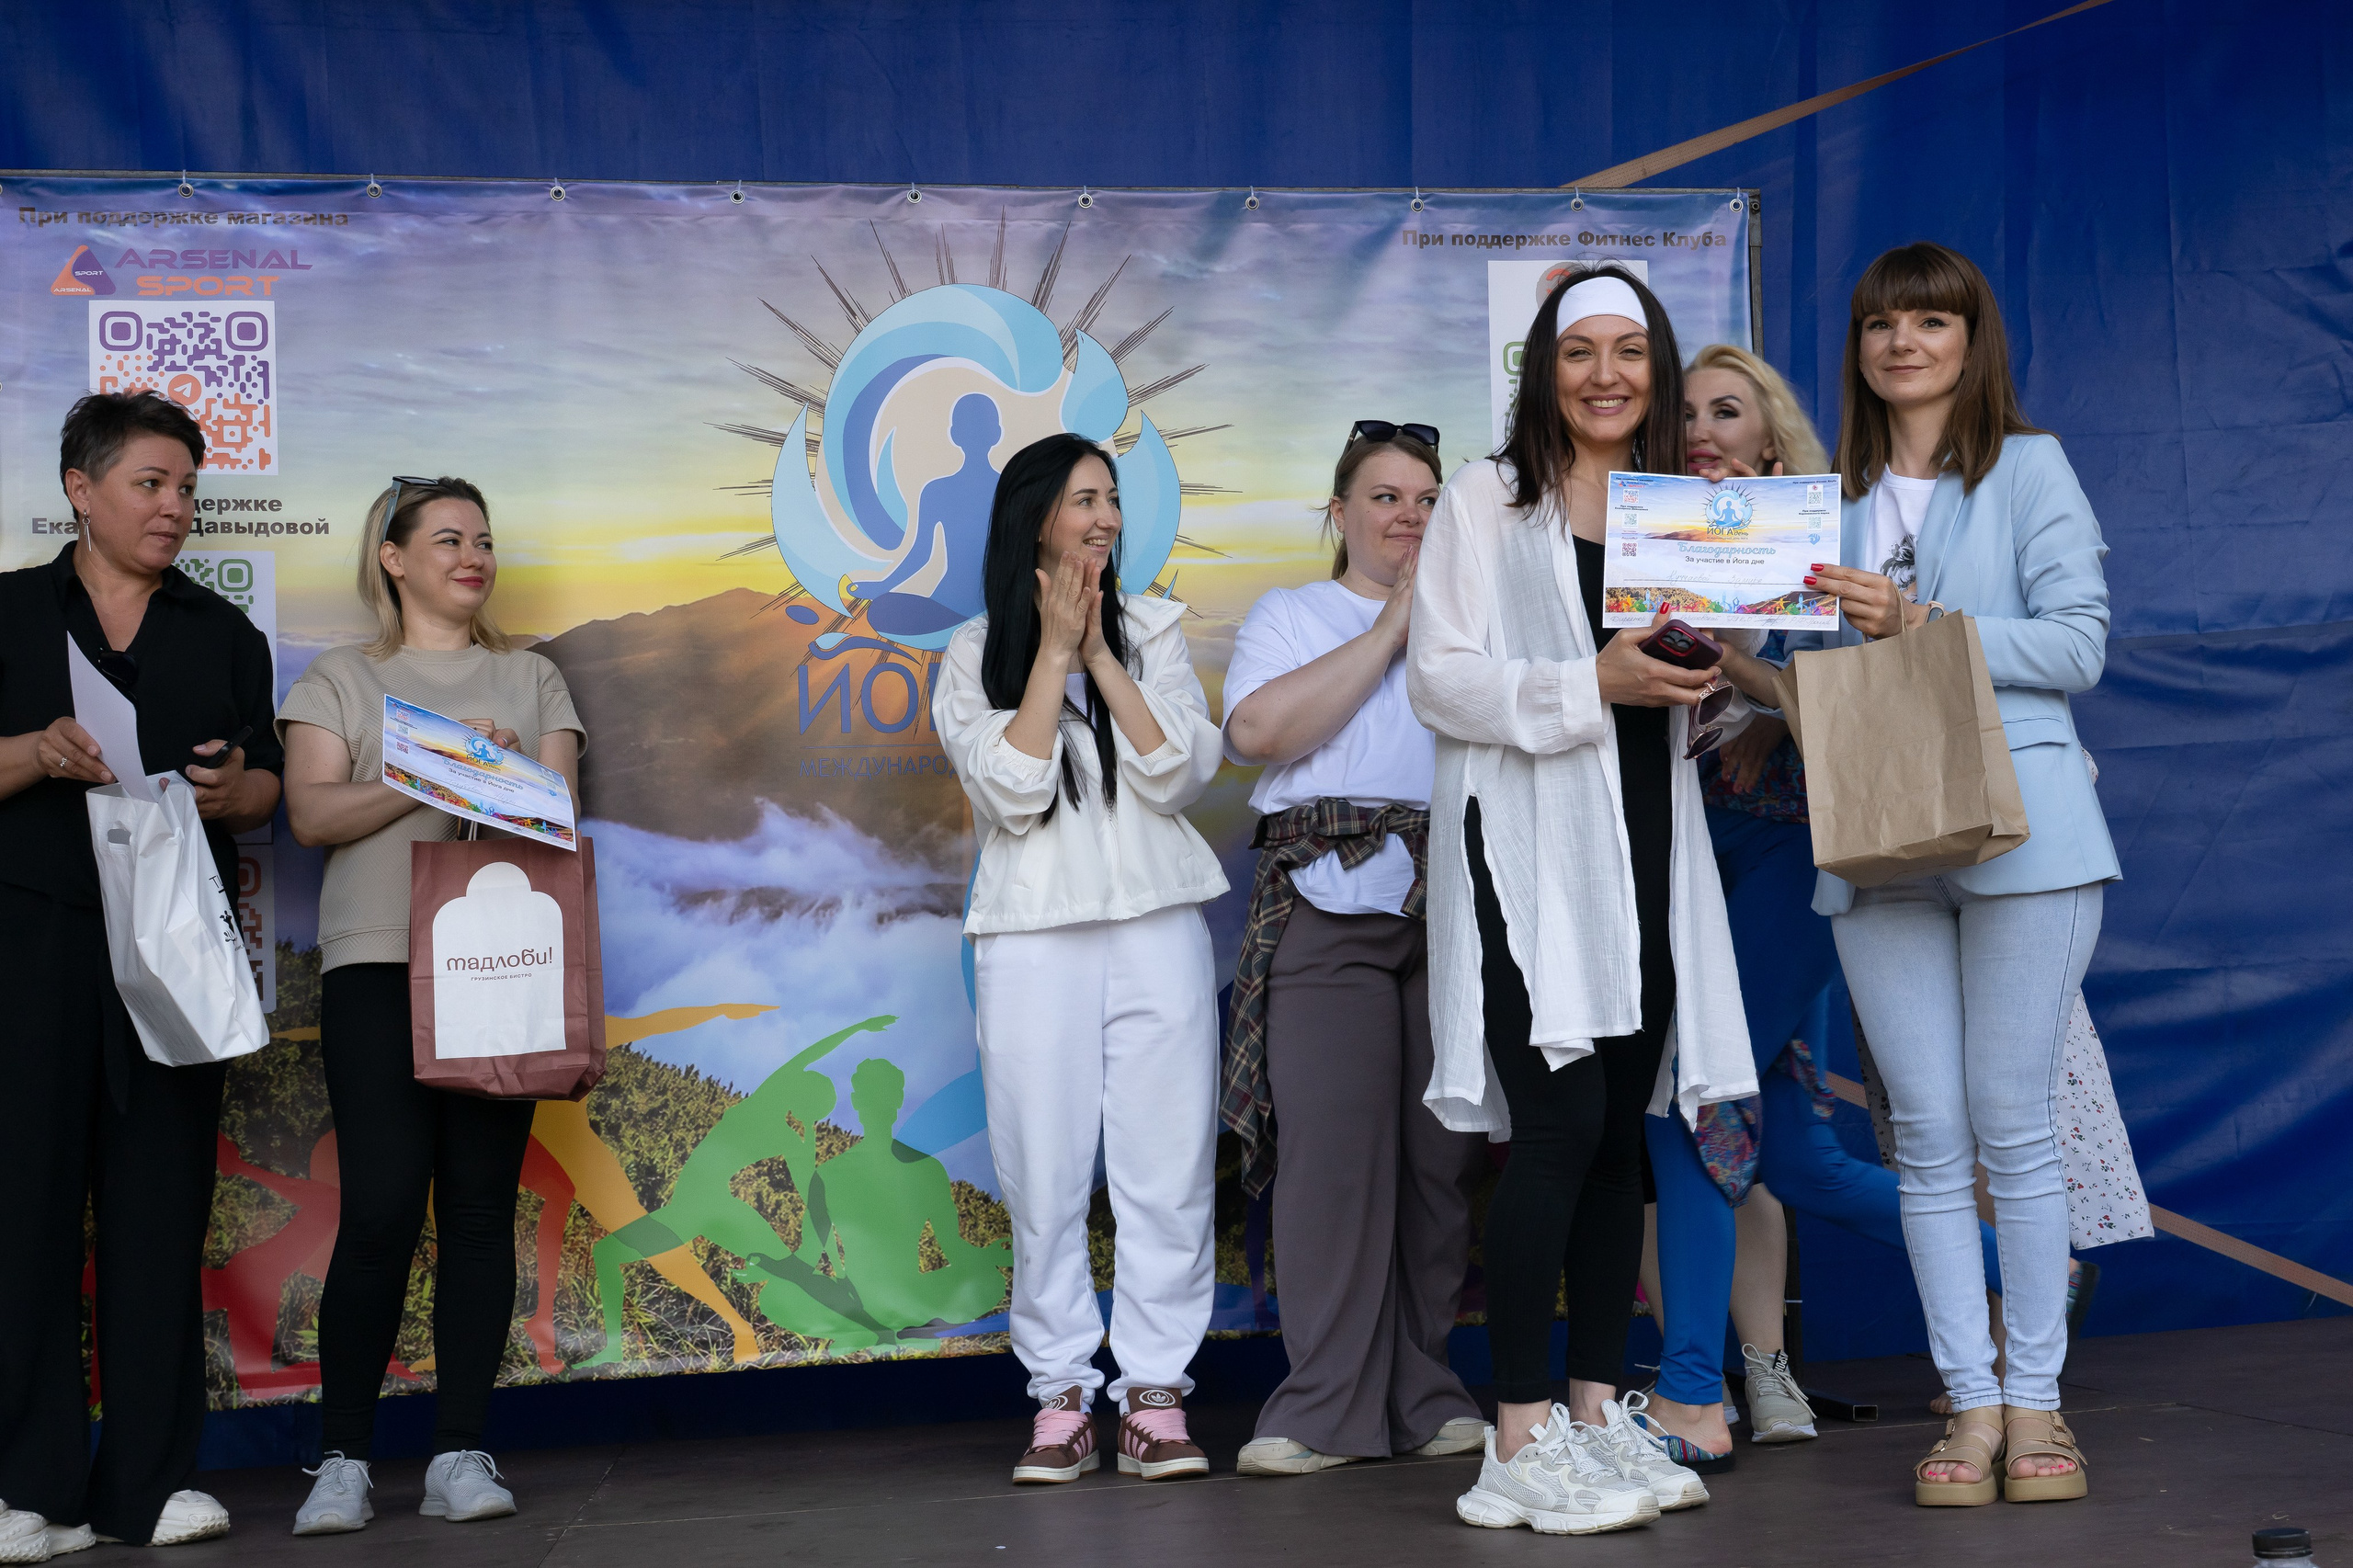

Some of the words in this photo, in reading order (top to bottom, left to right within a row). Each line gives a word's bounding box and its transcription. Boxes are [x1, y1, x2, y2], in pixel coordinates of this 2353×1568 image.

[18, 207, 68, 229] При
[77, 211, 219, 229] поддержке
[227, 210, 349, 227] магазина
[1403, 230, 1445, 250] При
[1451, 232, 1572, 250] поддержке
[1577, 231, 1655, 247] Фитнес
[1664, 231, 1727, 250] Клуба
[114, 248, 313, 270] ARSENAL
[137, 276, 281, 296] SPORT
[192, 498, 283, 515] держке
[188, 517, 330, 537] Давыдовой
[1677, 541, 1776, 558] Благодарность
[1733, 556, 1749, 564] Йога
[798, 634, 940, 735] ЙО
[442, 756, 523, 790] Благодарность
[800, 756, 957, 780] МЕЖДУНАРО
